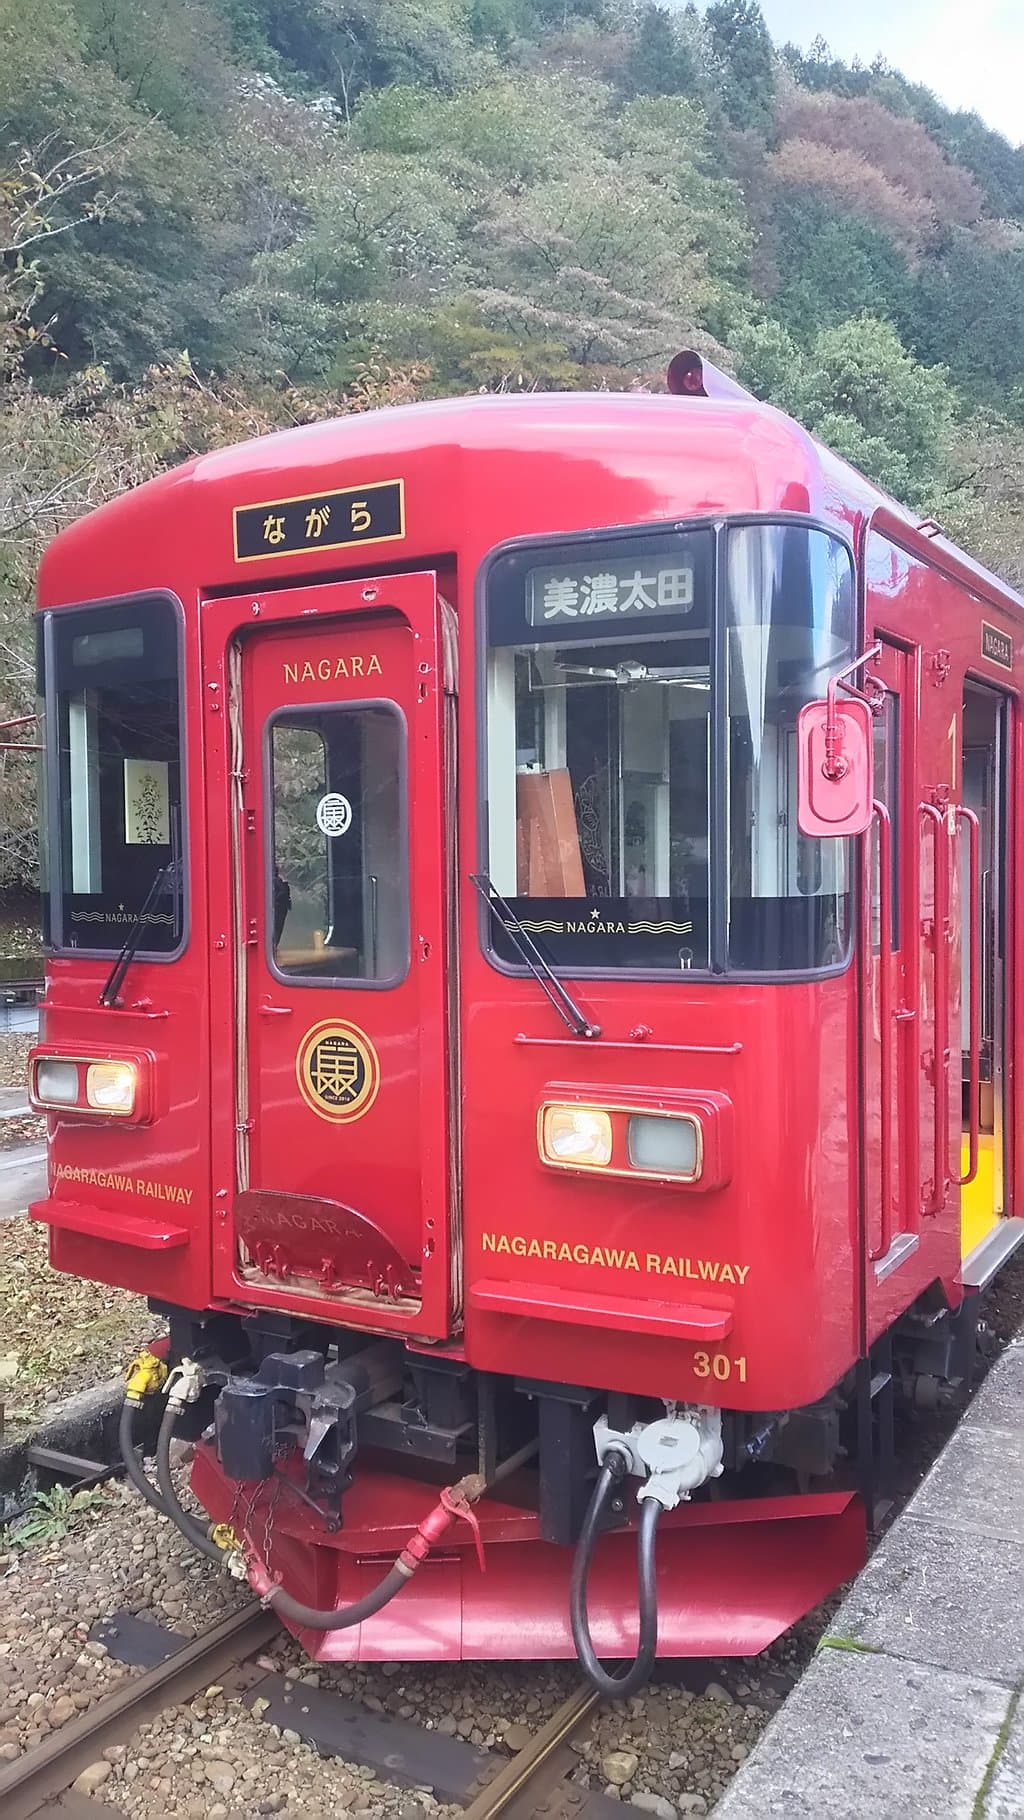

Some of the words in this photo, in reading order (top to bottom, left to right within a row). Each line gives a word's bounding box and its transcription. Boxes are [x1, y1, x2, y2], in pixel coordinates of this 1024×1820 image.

[263, 501, 372, 544] ながら
[543, 567, 694, 619] 美濃太田
[985, 632, 1009, 661] NAGARA
[283, 654, 383, 684] NAGARA
[104, 913, 139, 923] NAGARA
[566, 921, 626, 933] NAGARA
[50, 1161, 134, 1193] NAGARAGAWA
[136, 1179, 193, 1205] RAILWAY
[481, 1232, 640, 1271] NAGARAGAWA
[646, 1253, 750, 1285] RAILWAY
[692, 1351, 746, 1383] 301
